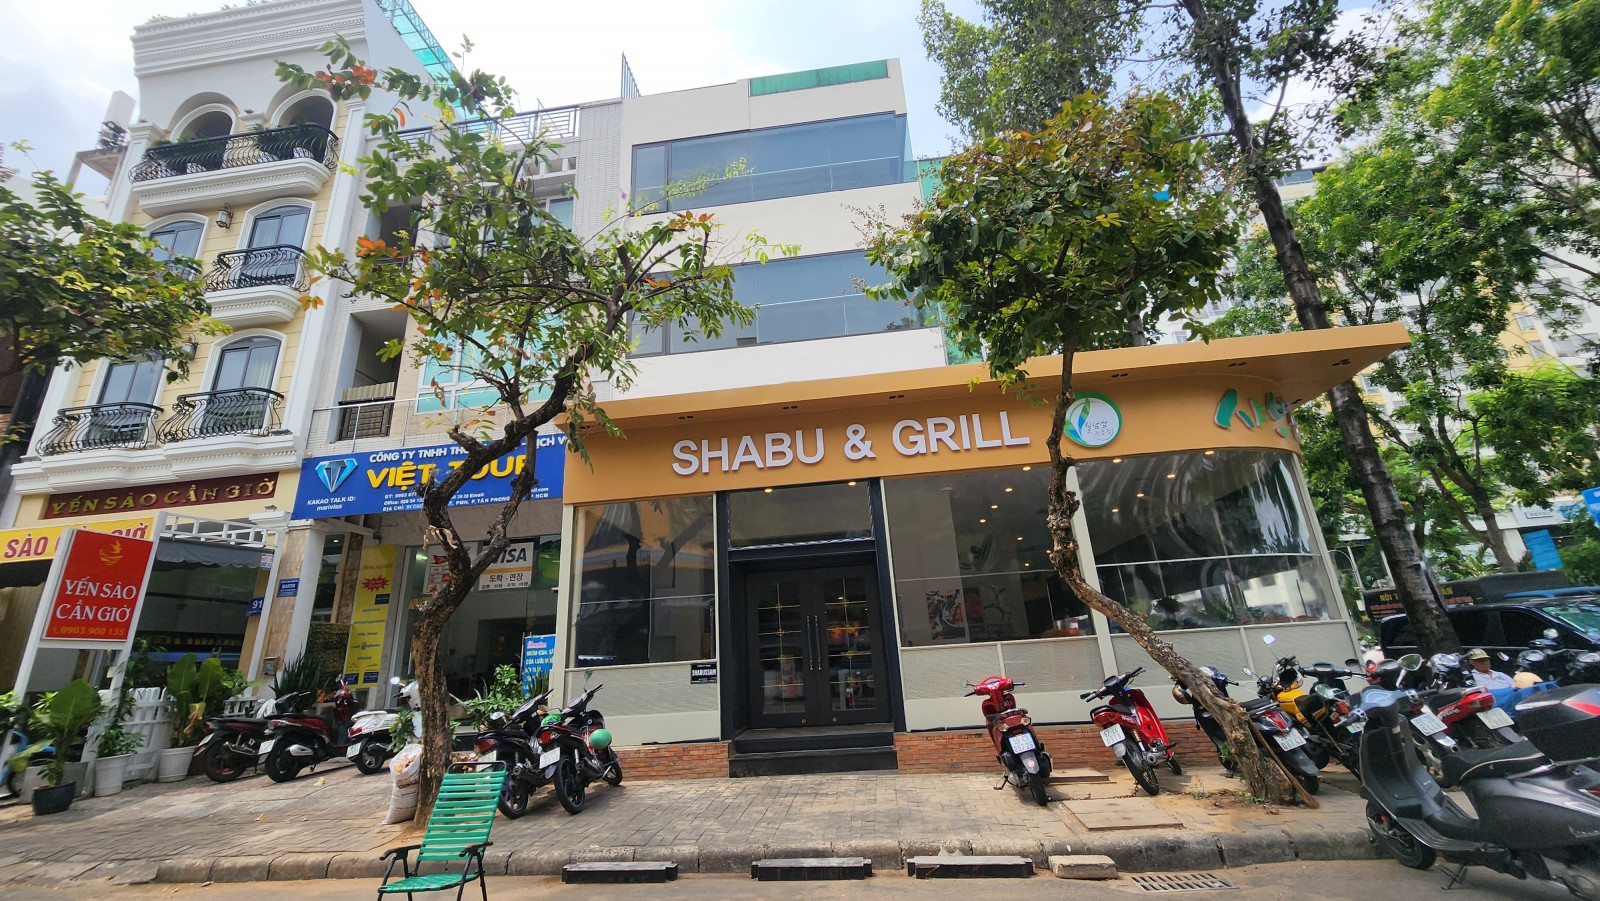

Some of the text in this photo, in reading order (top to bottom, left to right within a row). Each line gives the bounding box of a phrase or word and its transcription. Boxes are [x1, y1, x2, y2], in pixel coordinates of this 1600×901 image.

[369, 452, 399, 463] CÔNG
[402, 450, 415, 460] TY
[418, 447, 447, 458] TNHH
[671, 411, 1031, 476] SHABU & GRILL
[366, 460, 437, 491] VIỆT
[51, 477, 275, 515] YẾN SÀO CẦN GIỜ
[307, 498, 329, 506] KAKAO
[3, 533, 49, 559] SÀO
[495, 547, 527, 564] ISA
[65, 576, 137, 600] YẾN SÀO
[56, 599, 131, 623] CẦN GIỜ
[60, 626, 125, 636] 0903 900 135
